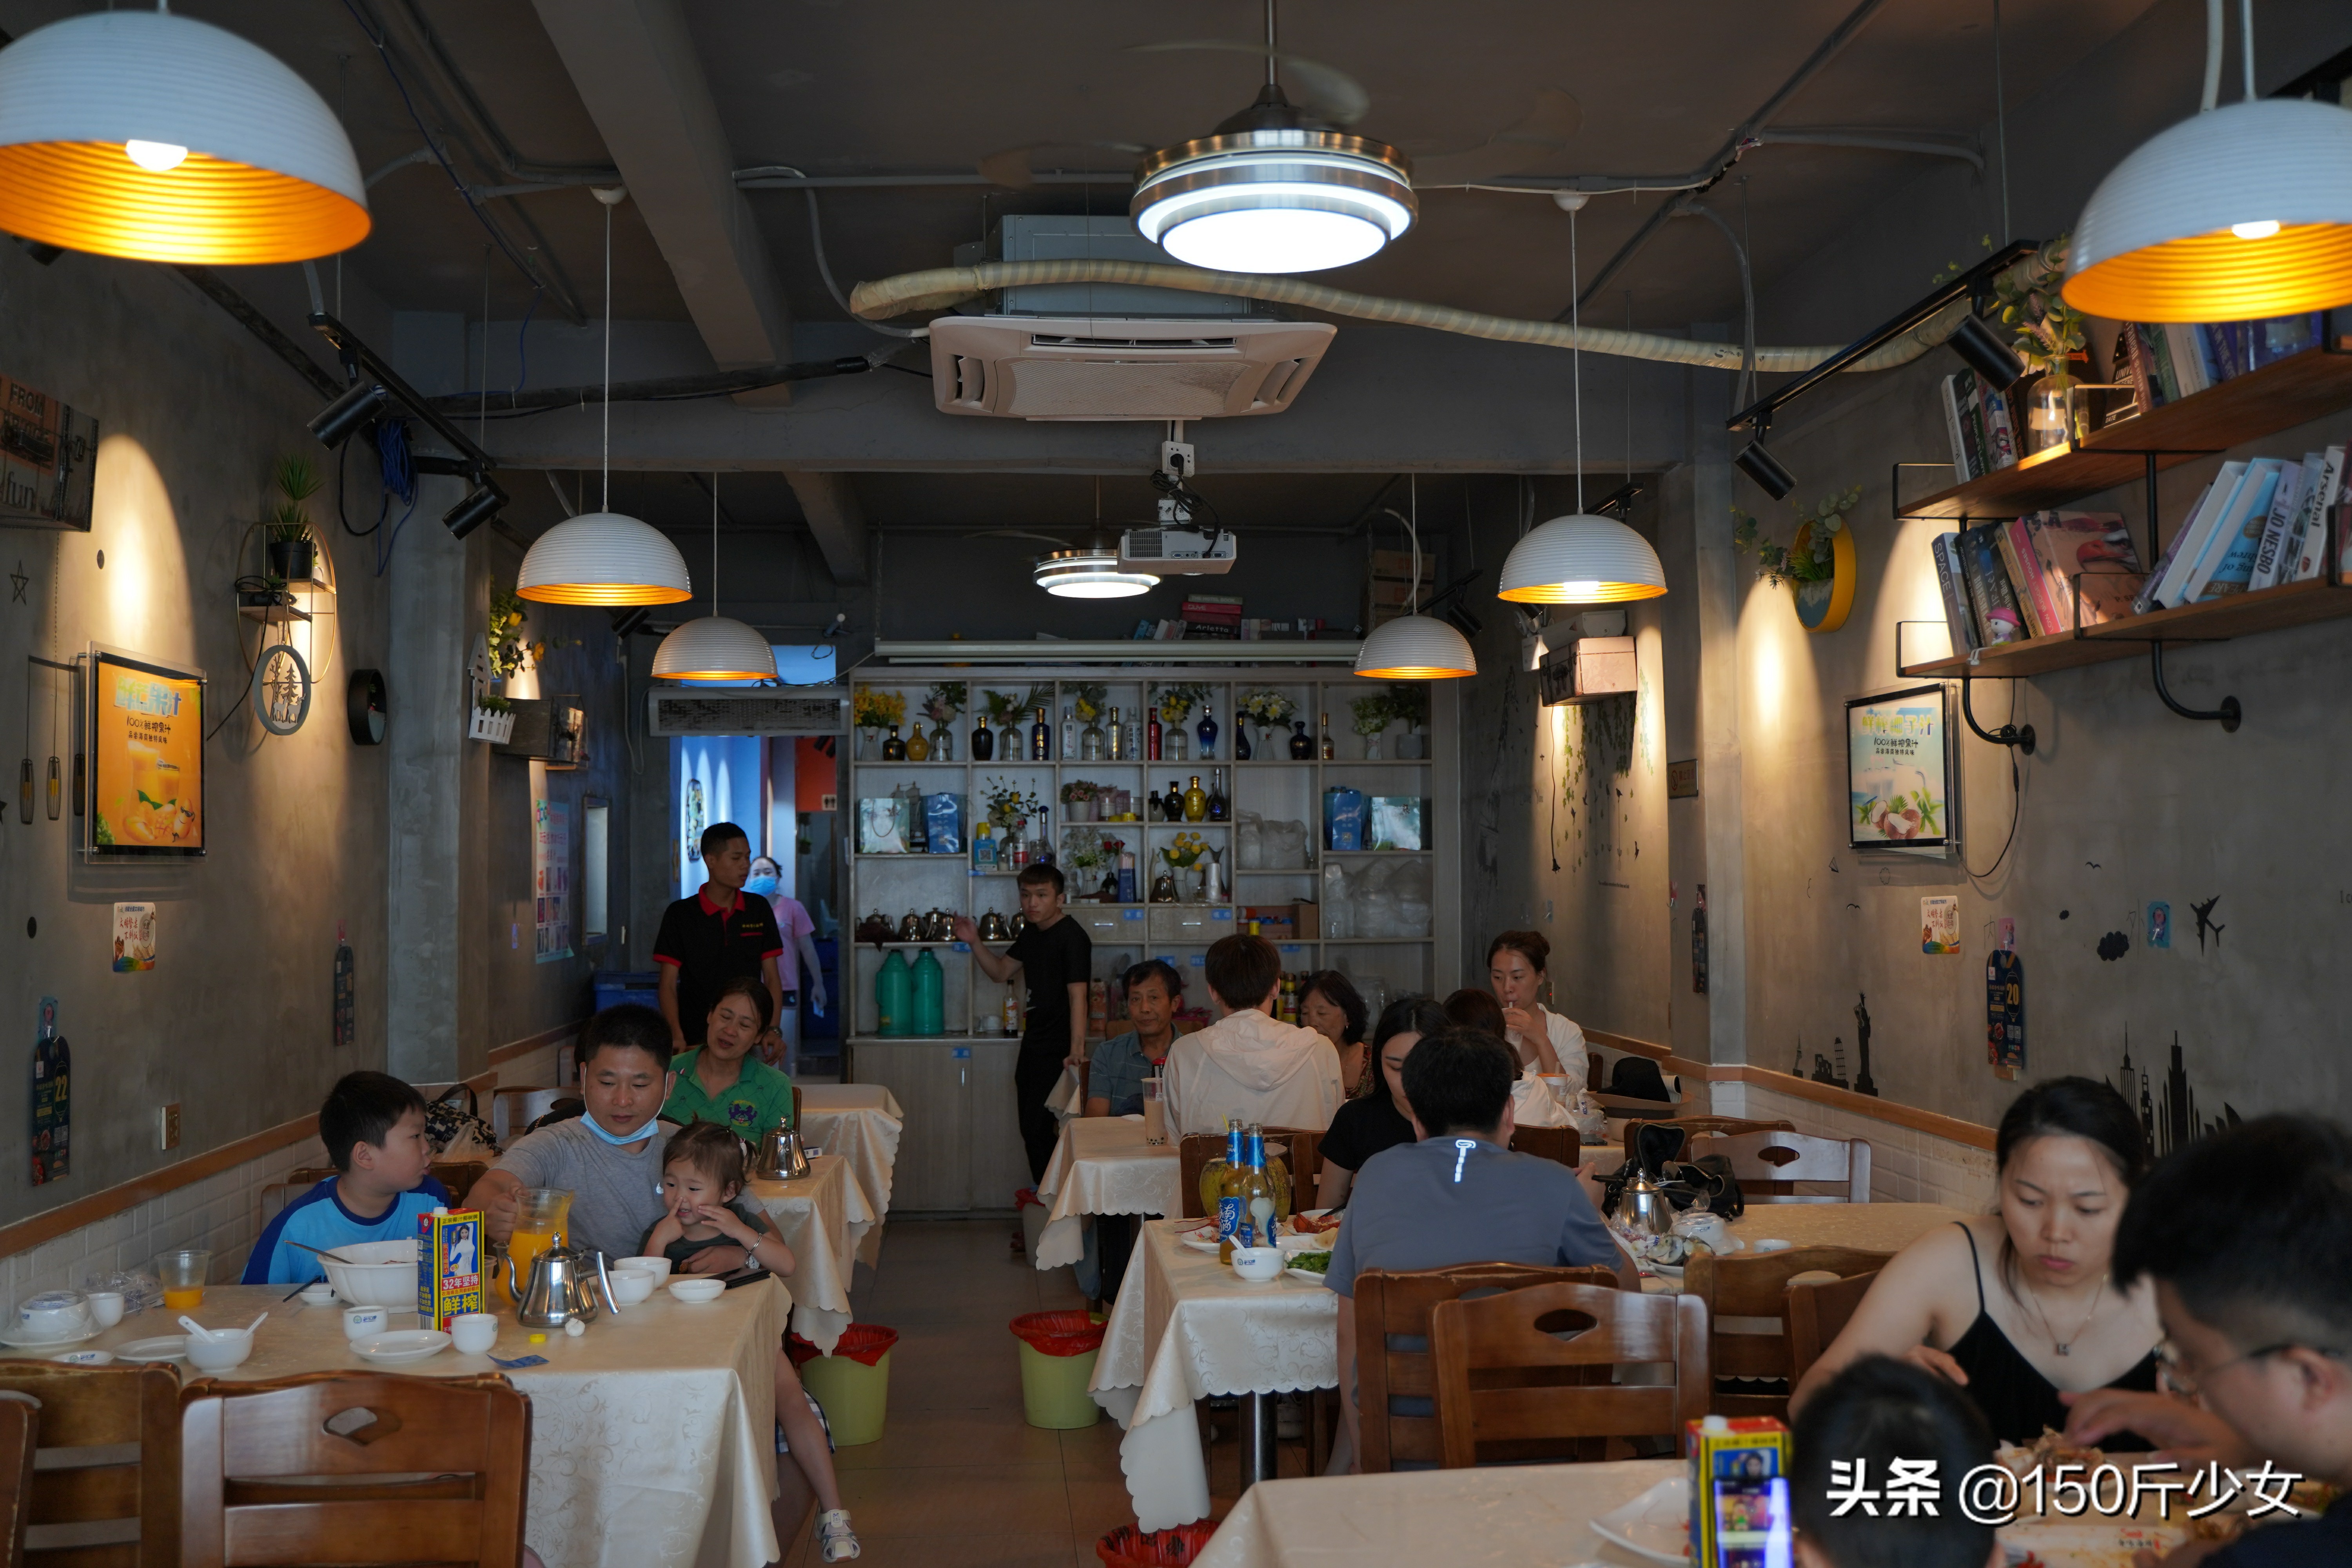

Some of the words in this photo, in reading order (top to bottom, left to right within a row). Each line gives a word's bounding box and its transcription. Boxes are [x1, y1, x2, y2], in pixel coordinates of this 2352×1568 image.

[10, 383, 45, 417] FROM
[2105, 414, 2116, 424] DATE
[2310, 461, 2334, 527] Arsenal
[2270, 507, 2286, 527] JO
[1933, 543, 1952, 593] SPACE
[1959, 546, 1969, 579] ARCHITECTURE
[2021, 548, 2035, 579] HOUSES
[2219, 564, 2233, 574] of
[1999, 578, 2008, 595] West
[2032, 581, 2047, 612] BUDGET
[1196, 624, 1229, 633] Arletta
[2044, 613, 2054, 632] LOW
[115, 676, 181, 717] 鲜芒果汁
[2007, 983, 2020, 1006] 20
[55, 1075, 67, 1104] 22
[442, 1214, 478, 1224] 正宗椰汁椰树牌
[442, 1286, 479, 1296] 在海南岛用新鲜椰肉
[443, 1276, 479, 1290] 32年坚持
[443, 1294, 478, 1316] 鲜榨
